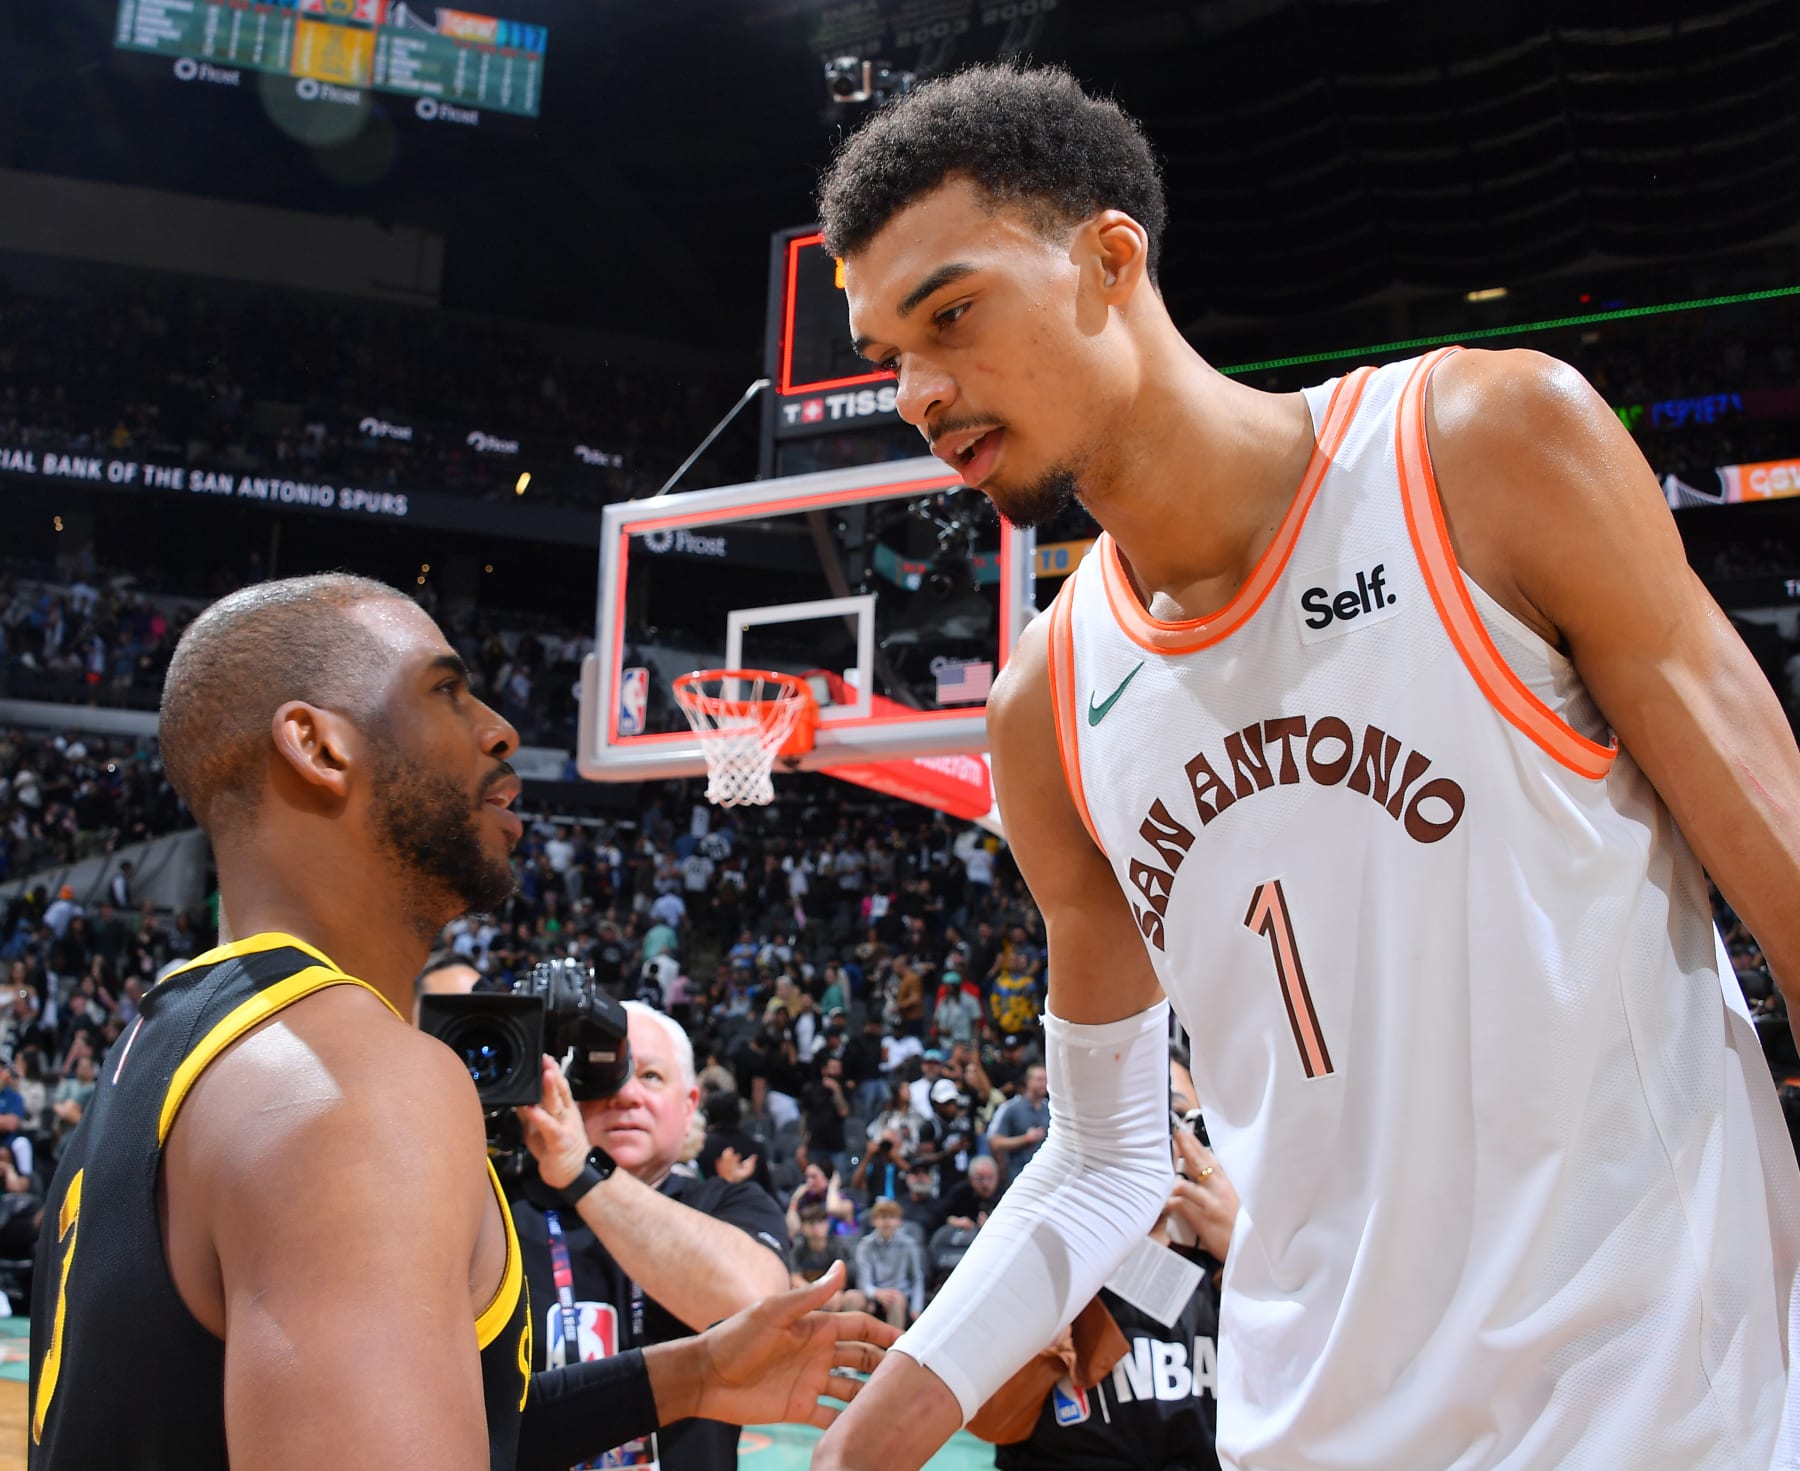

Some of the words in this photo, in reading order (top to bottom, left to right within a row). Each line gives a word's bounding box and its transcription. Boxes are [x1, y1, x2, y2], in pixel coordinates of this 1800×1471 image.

[42, 453, 103, 481] BANK
[106, 460, 139, 485] OF
[142, 464, 186, 491] THE
[188, 469, 235, 496] SAN
[237, 475, 336, 508] ANTONIO
[338, 487, 409, 517] SPURS
[1300, 564, 1397, 630] Self.
[1129, 797, 1196, 952] SAN
[1184, 714, 1466, 844] ANTONIO
[1242, 877, 1336, 1081] 1
[1112, 1335, 1218, 1404] NBA
